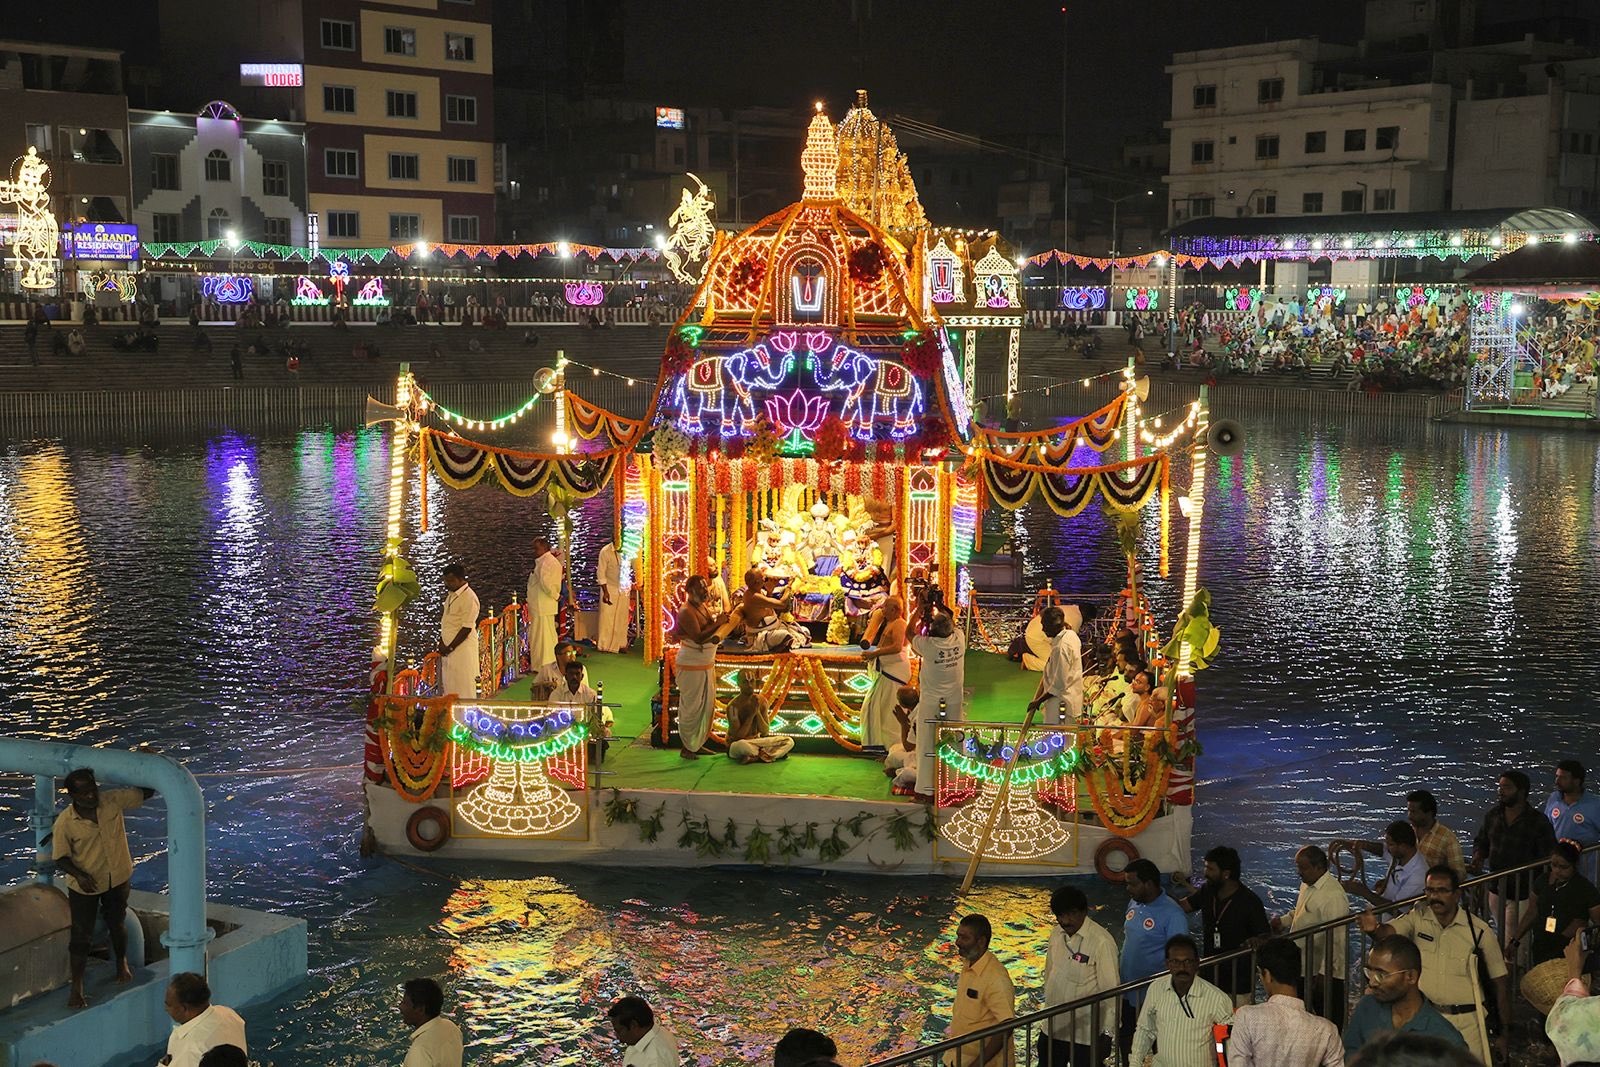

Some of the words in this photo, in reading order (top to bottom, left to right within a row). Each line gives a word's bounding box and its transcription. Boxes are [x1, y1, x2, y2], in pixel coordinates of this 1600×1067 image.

[265, 73, 301, 86] LODGE
[94, 233, 132, 242] GRAND
[77, 242, 123, 250] RESIDENCY
